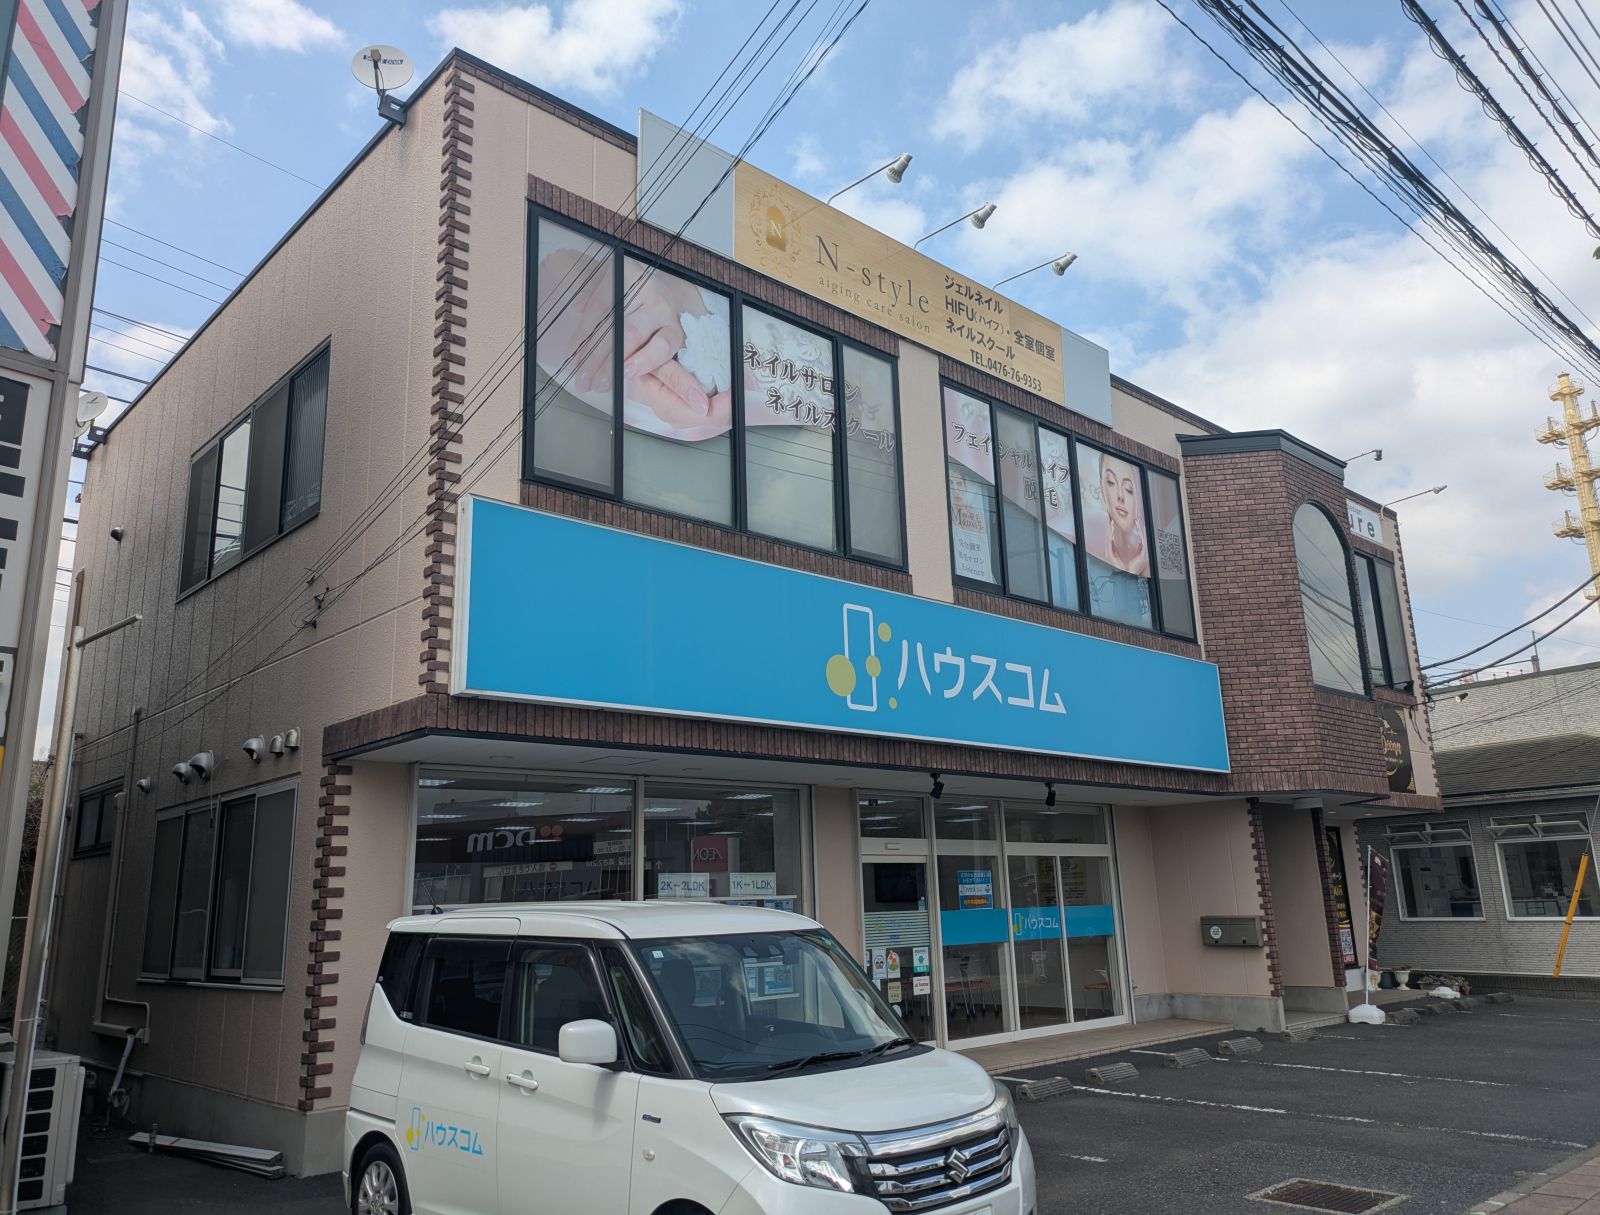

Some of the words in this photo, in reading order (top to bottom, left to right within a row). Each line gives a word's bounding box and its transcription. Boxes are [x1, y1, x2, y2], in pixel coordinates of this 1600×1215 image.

[815, 234, 929, 314] N-style
[944, 274, 1003, 314] ジェルネイル
[866, 298, 892, 316] care
[899, 313, 931, 334] salon
[945, 316, 1016, 361] ネイルスクール
[742, 342, 860, 401] ネイルサロン
[897, 639, 1067, 714] ハウスコム
[1024, 912, 1059, 930] ハウスコム
[424, 1120, 483, 1155] ハウスコム
